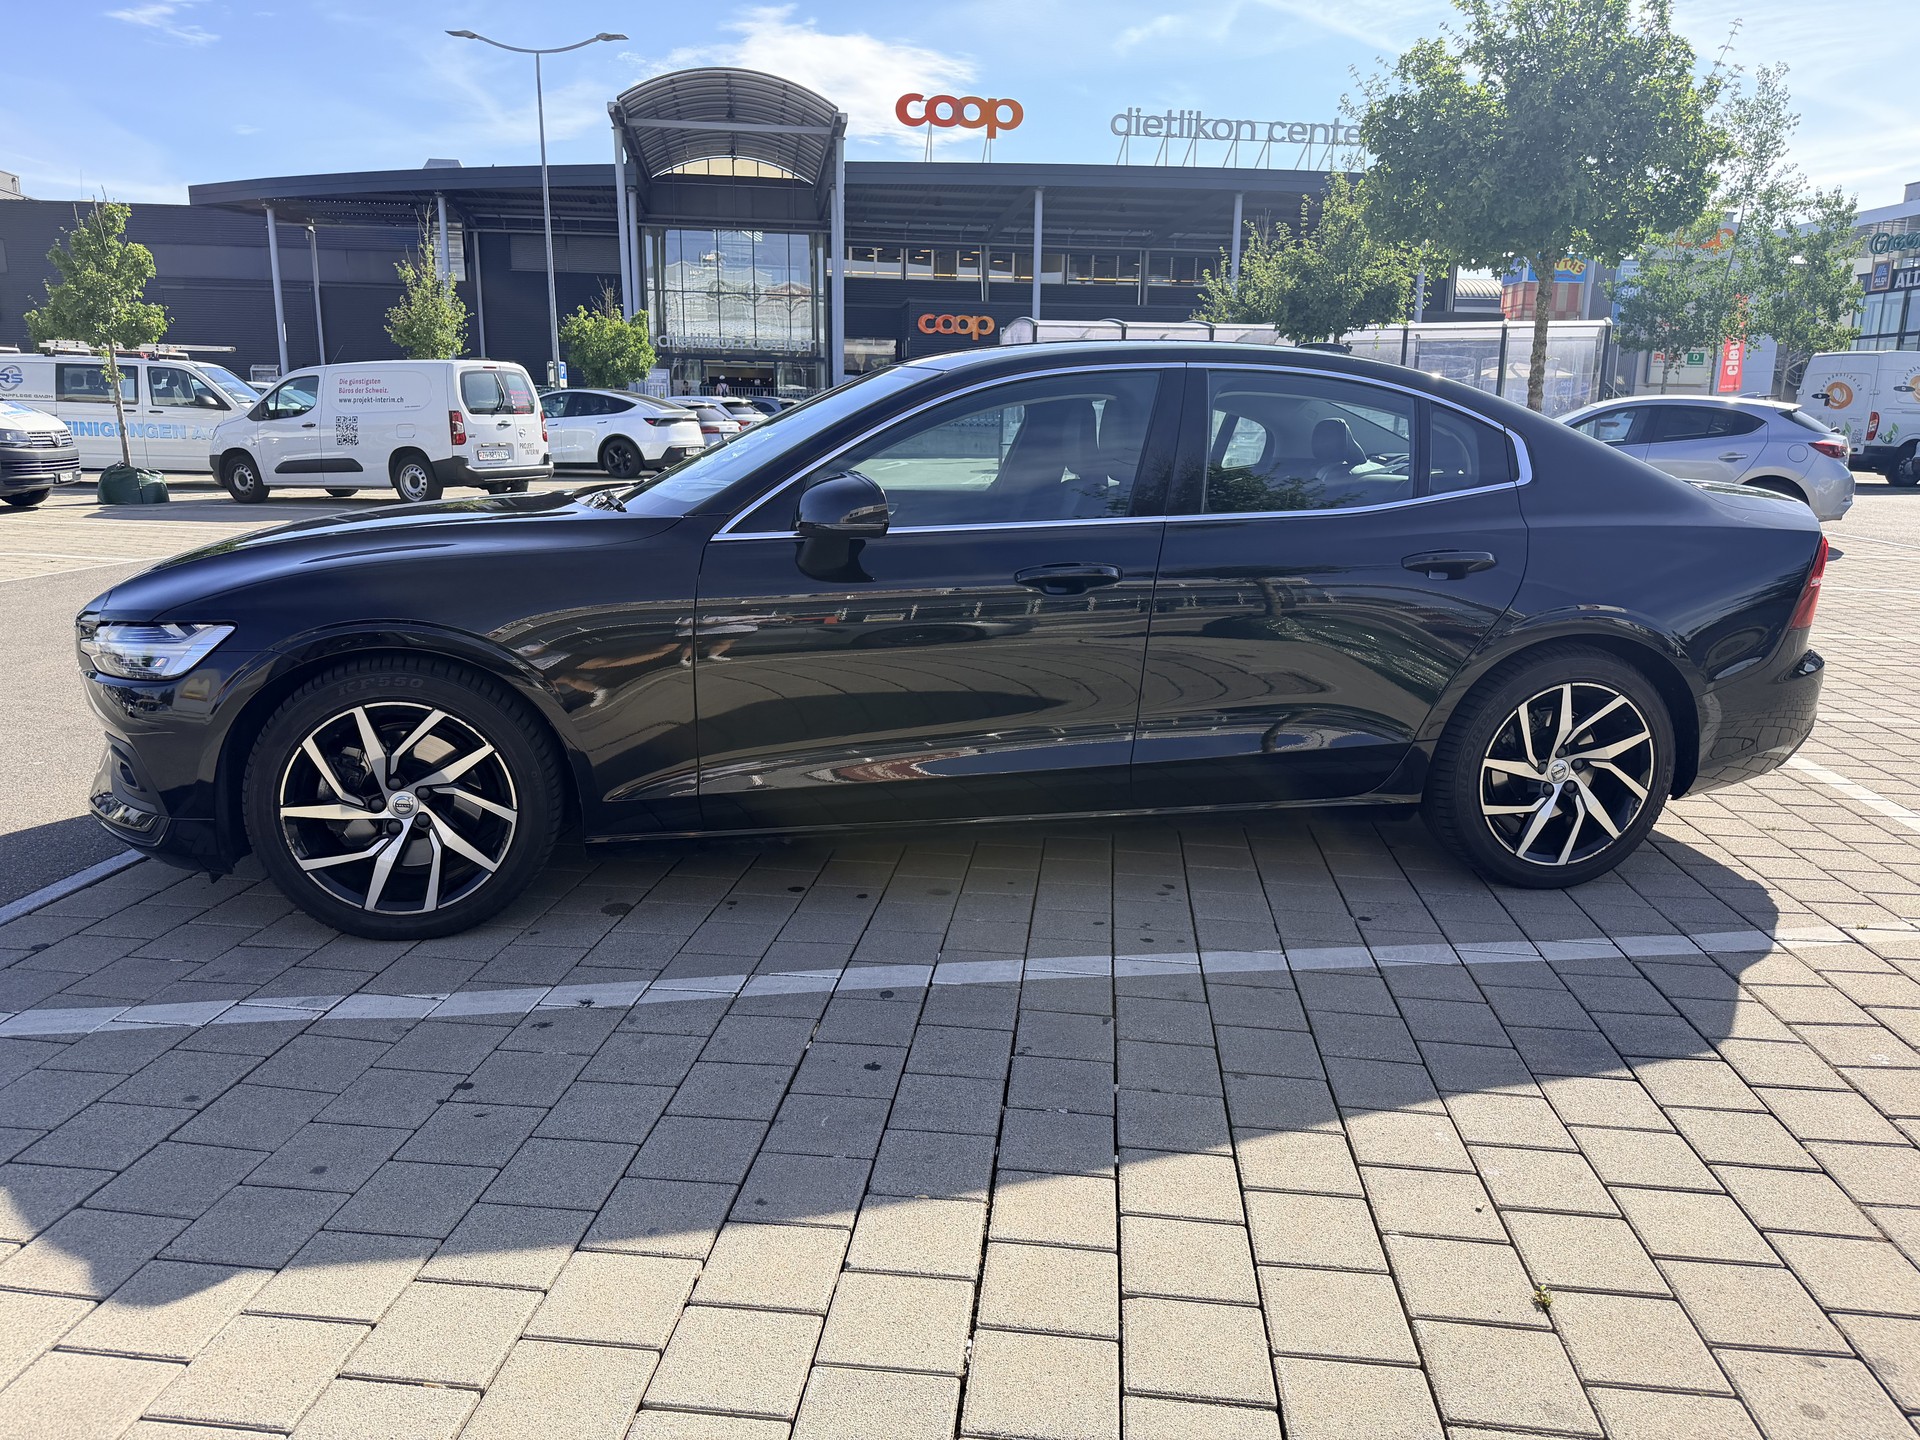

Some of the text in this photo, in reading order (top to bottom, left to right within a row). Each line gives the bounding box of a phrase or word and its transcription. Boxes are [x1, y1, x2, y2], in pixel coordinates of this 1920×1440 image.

[895, 93, 1024, 139] coop
[1110, 107, 1362, 146] dietlikon cente
[917, 313, 995, 341] coop
[657, 333, 816, 352] dietlikon center
[349, 378, 381, 386] günstigsten
[338, 396, 404, 404] www.projekt-interim.ch
[64, 420, 187, 439] EINIGUNGEN
